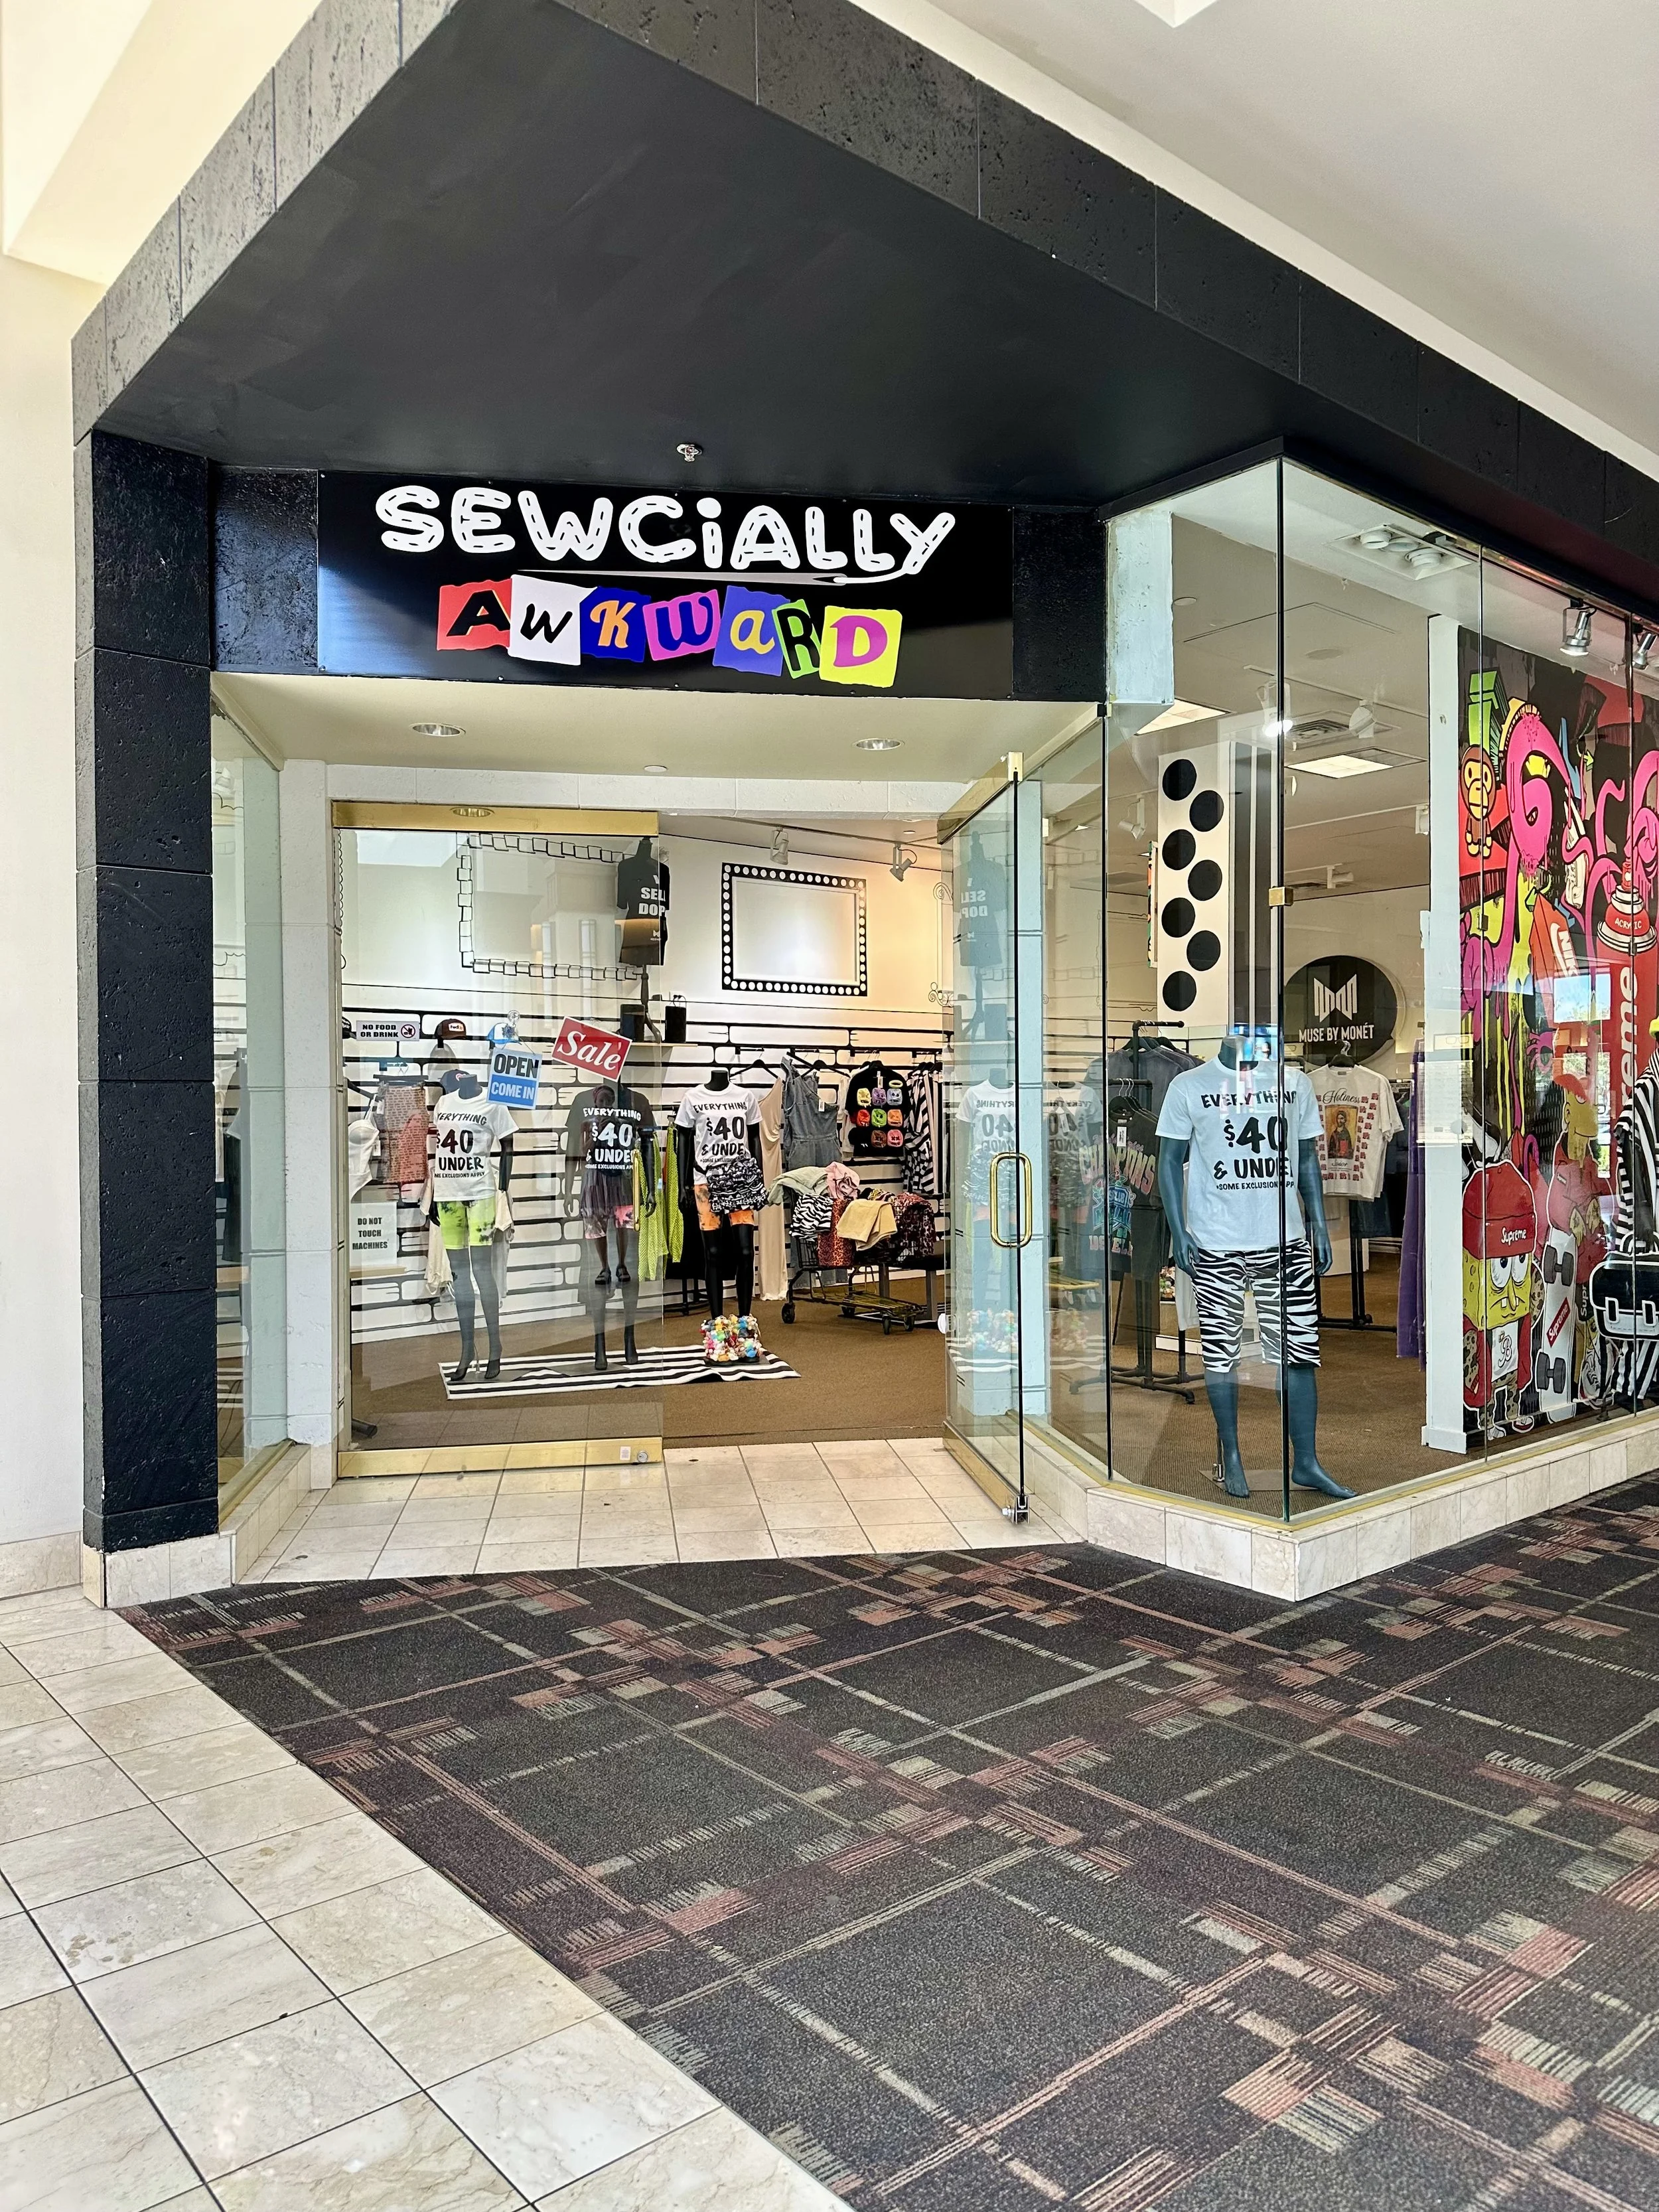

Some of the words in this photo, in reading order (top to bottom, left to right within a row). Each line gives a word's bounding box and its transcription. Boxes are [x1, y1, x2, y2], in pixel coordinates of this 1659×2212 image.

[638, 903, 666, 917] DOP
[1615, 917, 1642, 929] ACRYIC
[1558, 930, 1579, 977] NIK
[1299, 1027, 1325, 1042] MUSE
[1327, 1027, 1338, 1041] BY
[1341, 1022, 1374, 1040] MONÉT
[557, 1031, 621, 1070] Sale
[493, 1054, 540, 1078] OPEN
[491, 1082, 520, 1097] COME
[523, 1086, 535, 1100] IN
[1200, 1090, 1297, 1108] EVERYTHN
[1323, 1088, 1360, 1104] Holiness
[437, 1112, 486, 1126] VERYTHING
[583, 1107, 641, 1121] EVERYTHING
[592, 1122, 632, 1147] $40
[706, 1116, 745, 1140] $40
[1224, 1116, 1288, 1153] $40
[701, 1143, 709, 1155] &
[712, 1142, 746, 1155] UNDE
[439, 1157, 484, 1171] UNDER
[1214, 1160, 1228, 1179] &
[1501, 1226, 1526, 1246] Supreme
[352, 1241, 388, 1250] MACHINES
